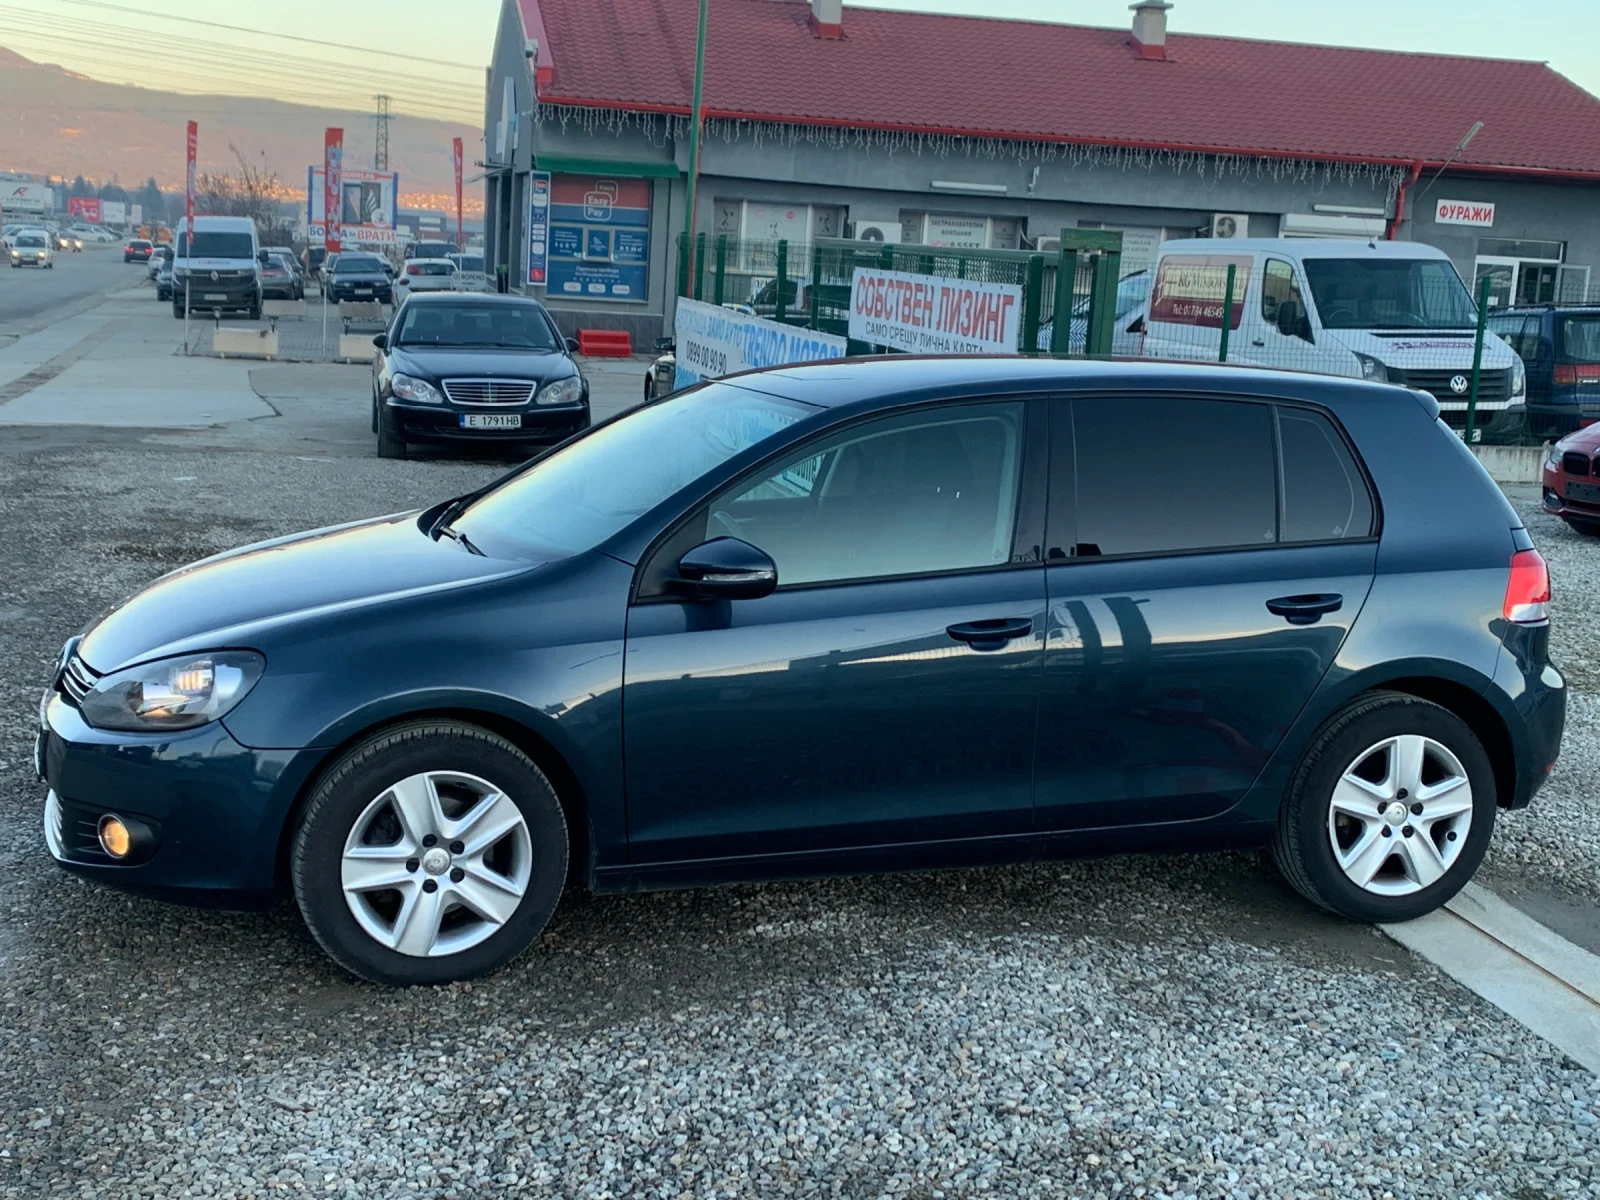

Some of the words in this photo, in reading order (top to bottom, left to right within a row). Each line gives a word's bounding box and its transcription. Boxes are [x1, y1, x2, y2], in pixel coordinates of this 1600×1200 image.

[588, 195, 608, 206] Easy
[588, 207, 604, 217] Pay
[1439, 204, 1493, 223] ФУРАЖИ
[309, 227, 348, 239] БОА
[357, 229, 396, 242] ВРАТИ
[856, 275, 935, 329] СОБСТВЕН
[936, 286, 1015, 344] ЛИЗИНГ
[743, 323, 787, 367] TRENDO
[866, 321, 888, 338] САМО
[889, 325, 918, 344] СРЕЩУ
[920, 333, 950, 352] ЛИЧНА
[953, 340, 984, 352] КАРТА
[686, 340, 701, 364] 0899
[701, 343, 710, 368] 00
[710, 346, 719, 372] 90
[718, 351, 727, 375] 90
[469, 416, 476, 426] E
